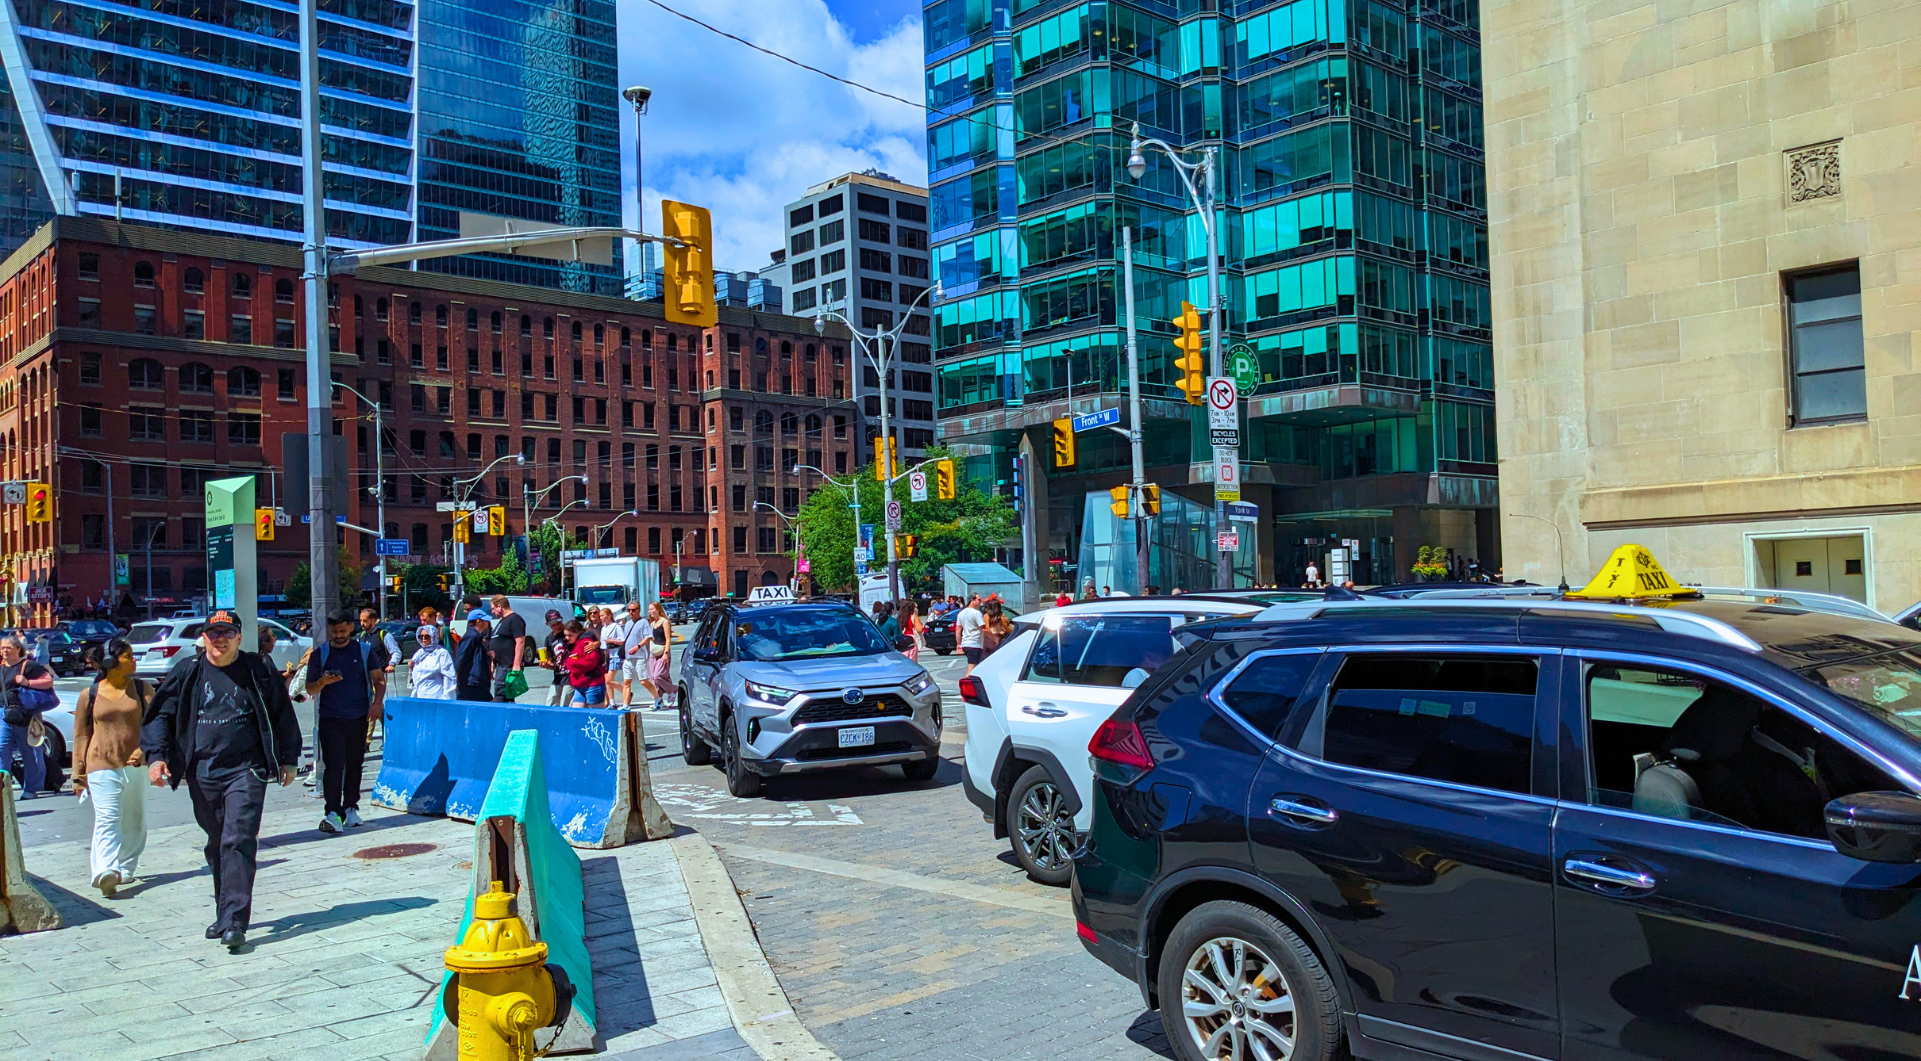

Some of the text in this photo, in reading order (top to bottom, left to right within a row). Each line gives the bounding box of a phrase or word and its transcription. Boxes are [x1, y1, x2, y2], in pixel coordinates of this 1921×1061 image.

[1235, 357, 1249, 378] P
[1210, 409, 1219, 417] 7AM
[1224, 409, 1235, 417] 10AM
[1081, 414, 1099, 427] Front
[1103, 411, 1110, 422] W
[1211, 416, 1220, 424] 3PM
[1226, 416, 1235, 424] 7PM
[1220, 456, 1233, 464] BLOCK
[1234, 506, 1245, 514] York
[1637, 571, 1670, 591] TAXI
[755, 586, 788, 599] TAXI
